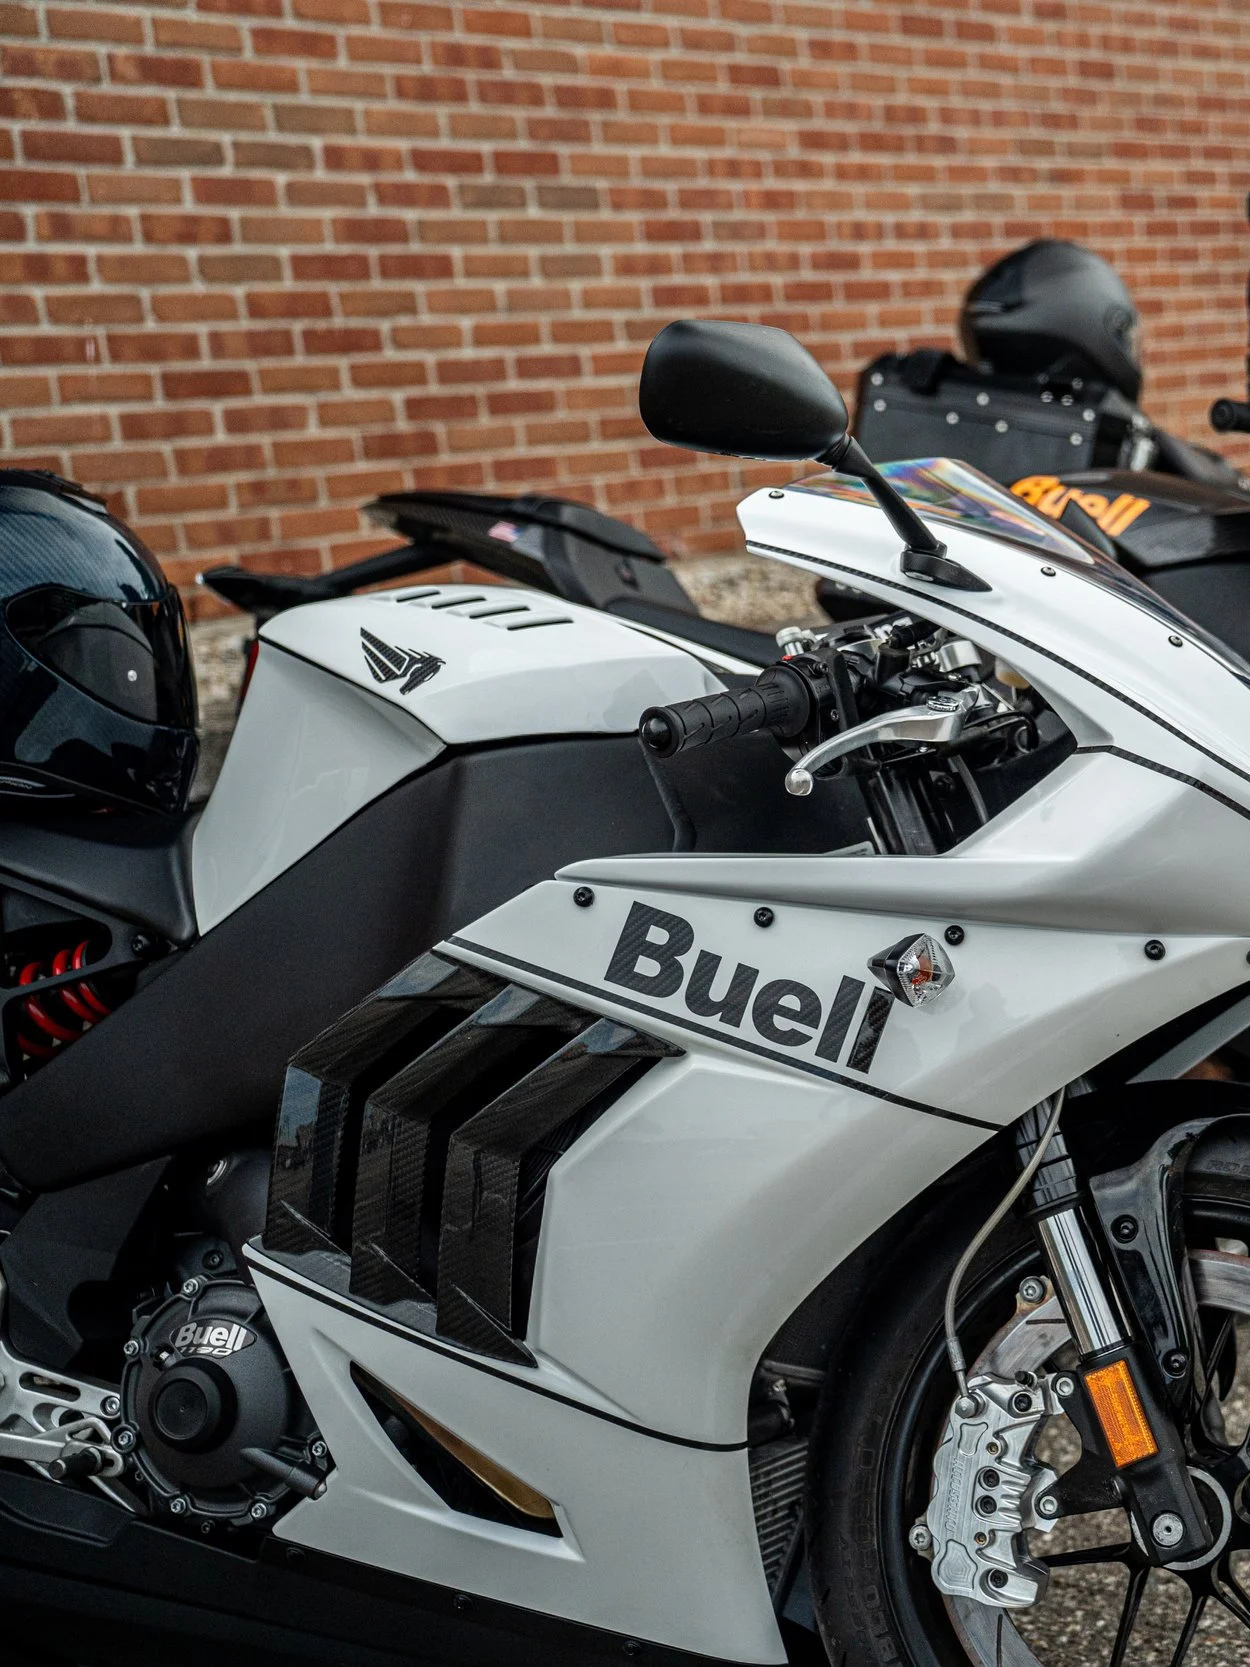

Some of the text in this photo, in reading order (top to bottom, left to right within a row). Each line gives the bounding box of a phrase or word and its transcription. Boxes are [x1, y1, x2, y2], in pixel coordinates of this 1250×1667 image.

[1009, 475, 1151, 537] Buell
[604, 900, 894, 1074] Buell
[174, 1322, 248, 1351] Buell
[180, 1346, 233, 1356] 1190
